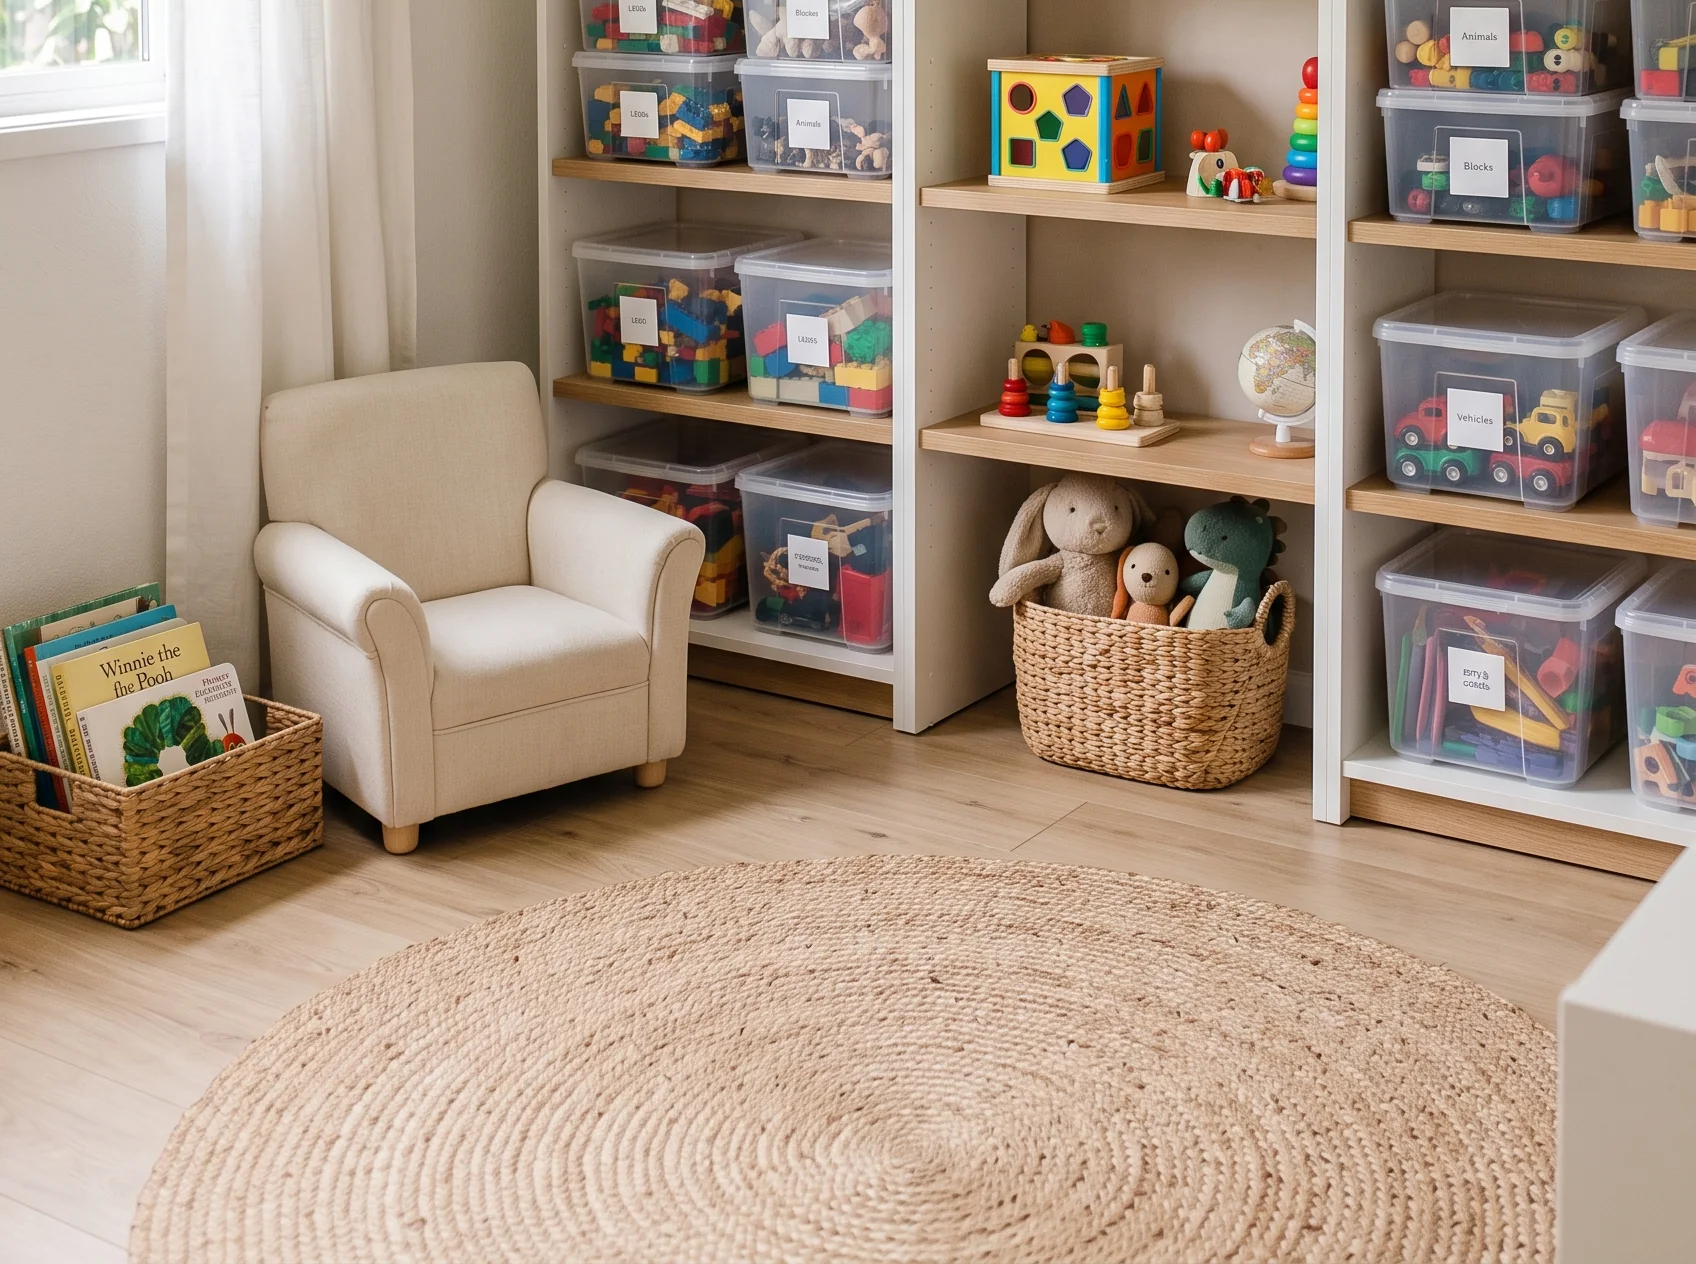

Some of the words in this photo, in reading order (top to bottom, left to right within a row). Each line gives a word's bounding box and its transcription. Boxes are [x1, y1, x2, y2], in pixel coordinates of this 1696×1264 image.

[1461, 32, 1498, 41] Animals
[1463, 162, 1494, 172] Blocks
[1457, 413, 1494, 425] Vehicles
[99, 651, 155, 679] Winnie
[158, 644, 182, 662] the
[136, 666, 173, 691] Pooh
